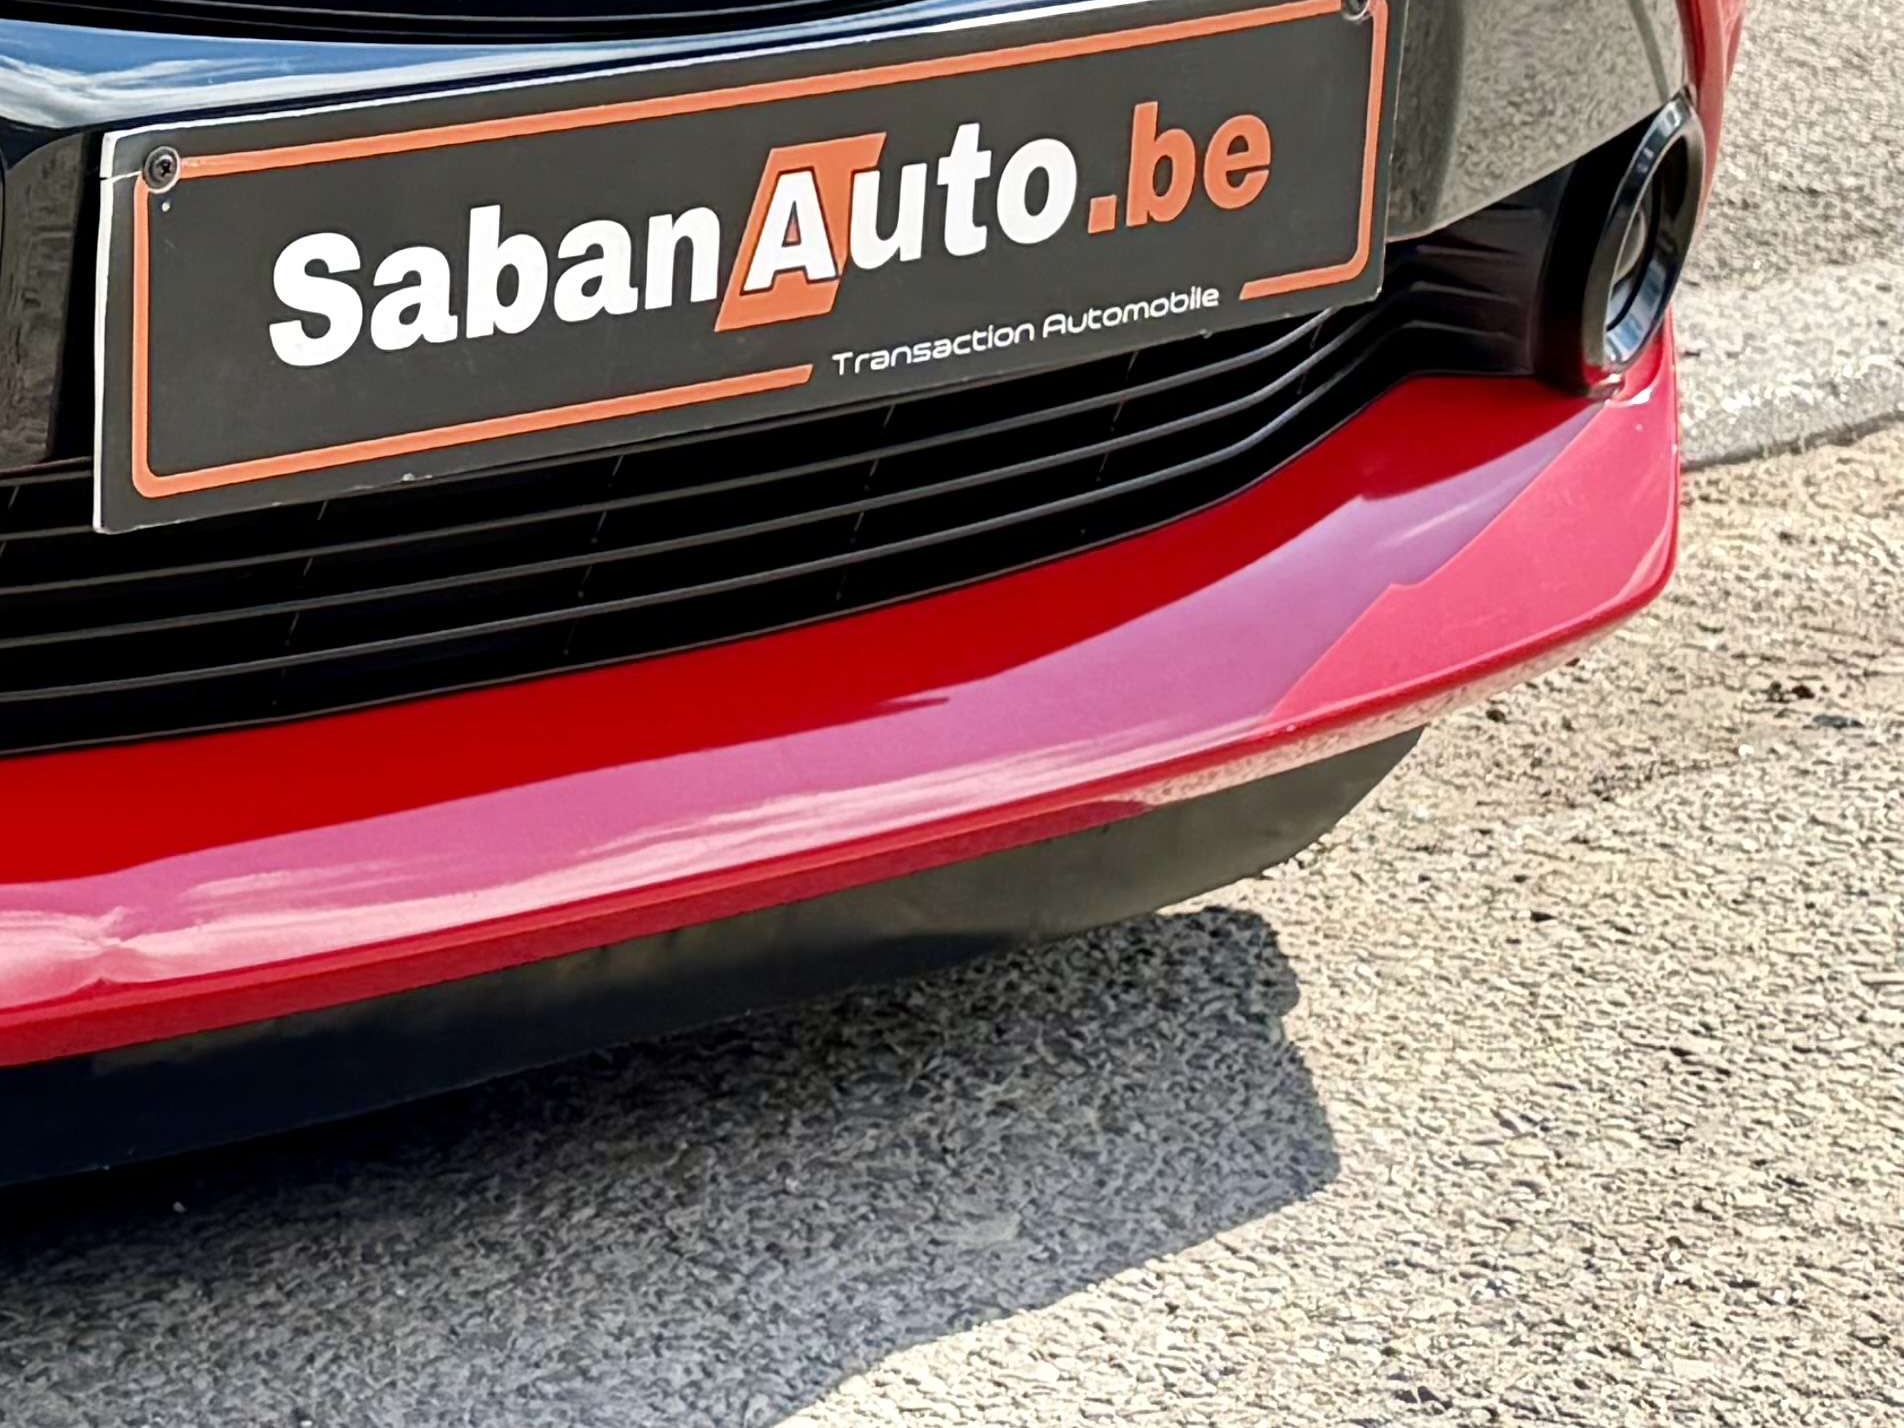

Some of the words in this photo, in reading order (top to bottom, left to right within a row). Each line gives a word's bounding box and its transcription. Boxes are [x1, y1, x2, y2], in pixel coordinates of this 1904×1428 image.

[267, 100, 1273, 368] SabanAuto.be
[831, 318, 1037, 379] Transaction
[1041, 282, 1221, 341] Automobile
